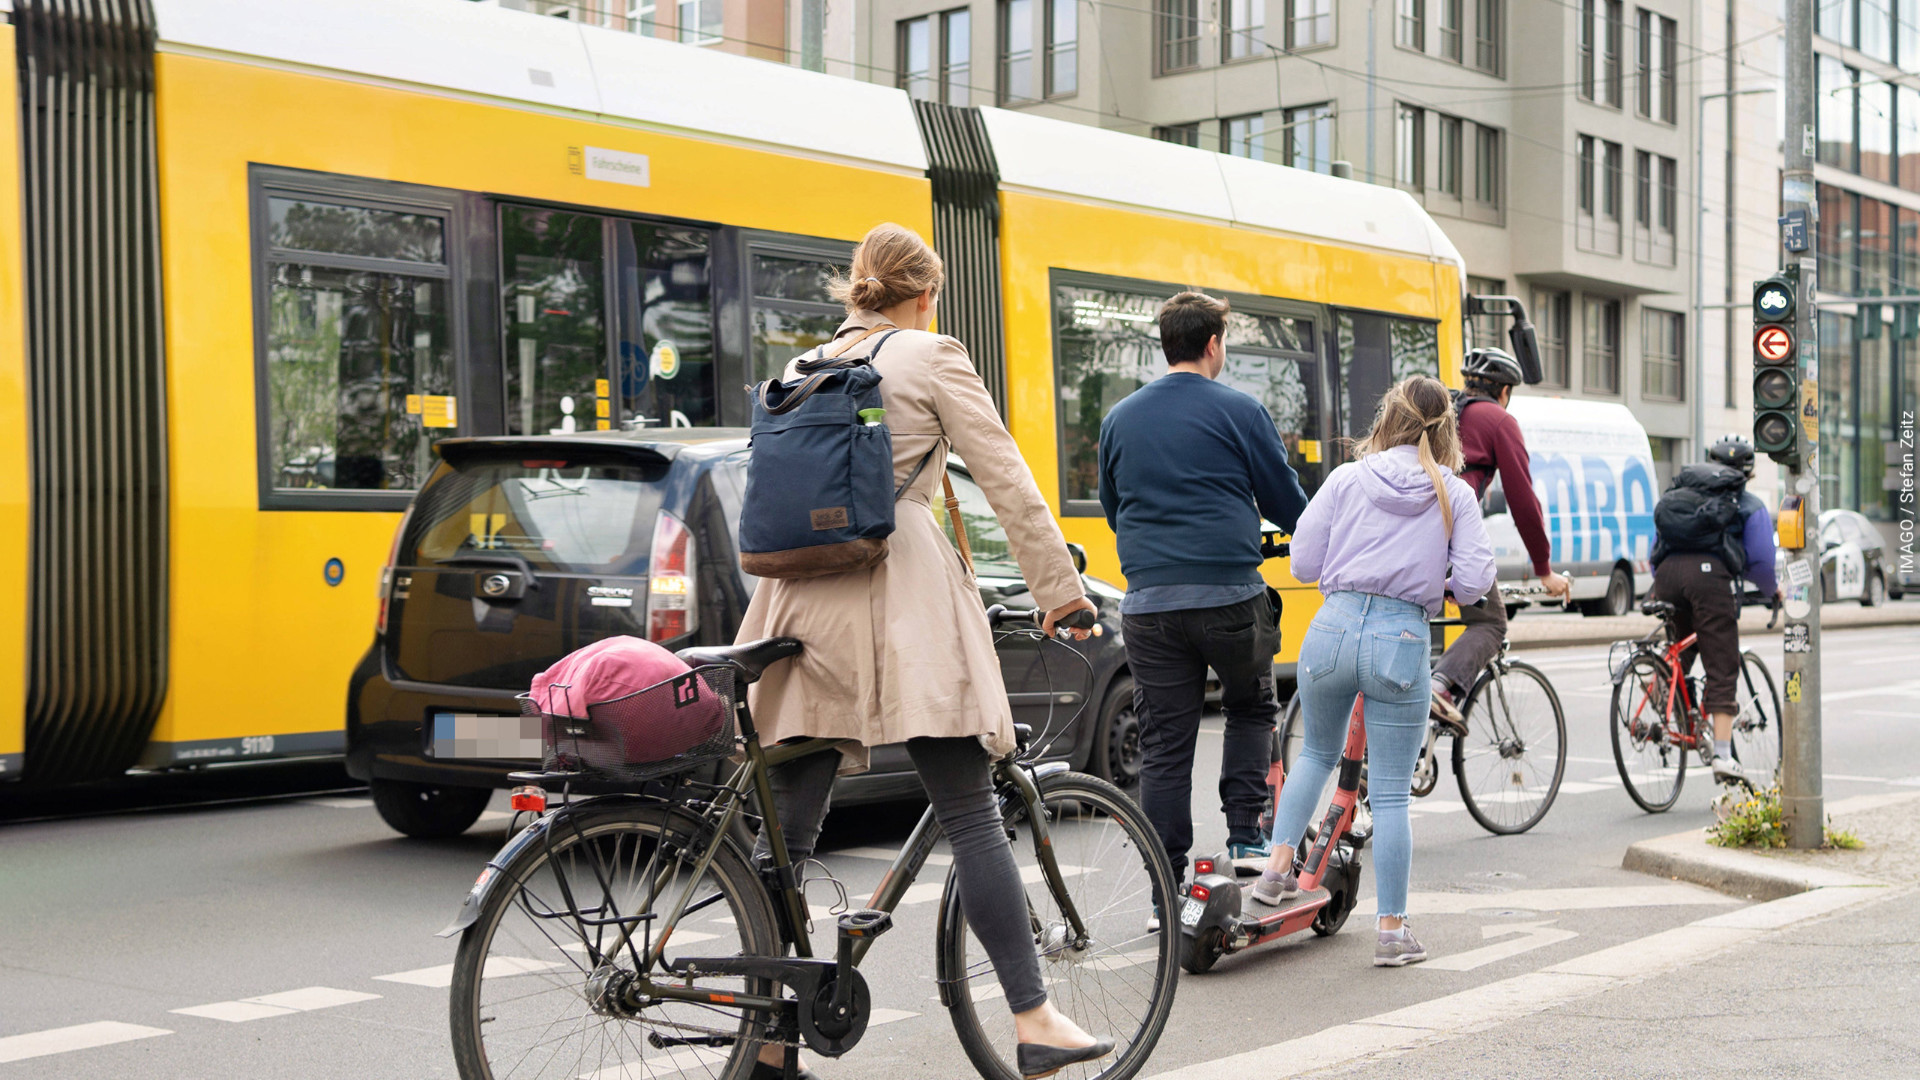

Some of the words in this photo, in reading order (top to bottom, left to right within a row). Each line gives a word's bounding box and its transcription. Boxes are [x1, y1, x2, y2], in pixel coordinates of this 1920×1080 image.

[592, 156, 642, 175] Fahrscheine
[241, 735, 275, 755] 9110
[1186, 901, 1202, 915] 575
[1182, 911, 1199, 923] WCH
